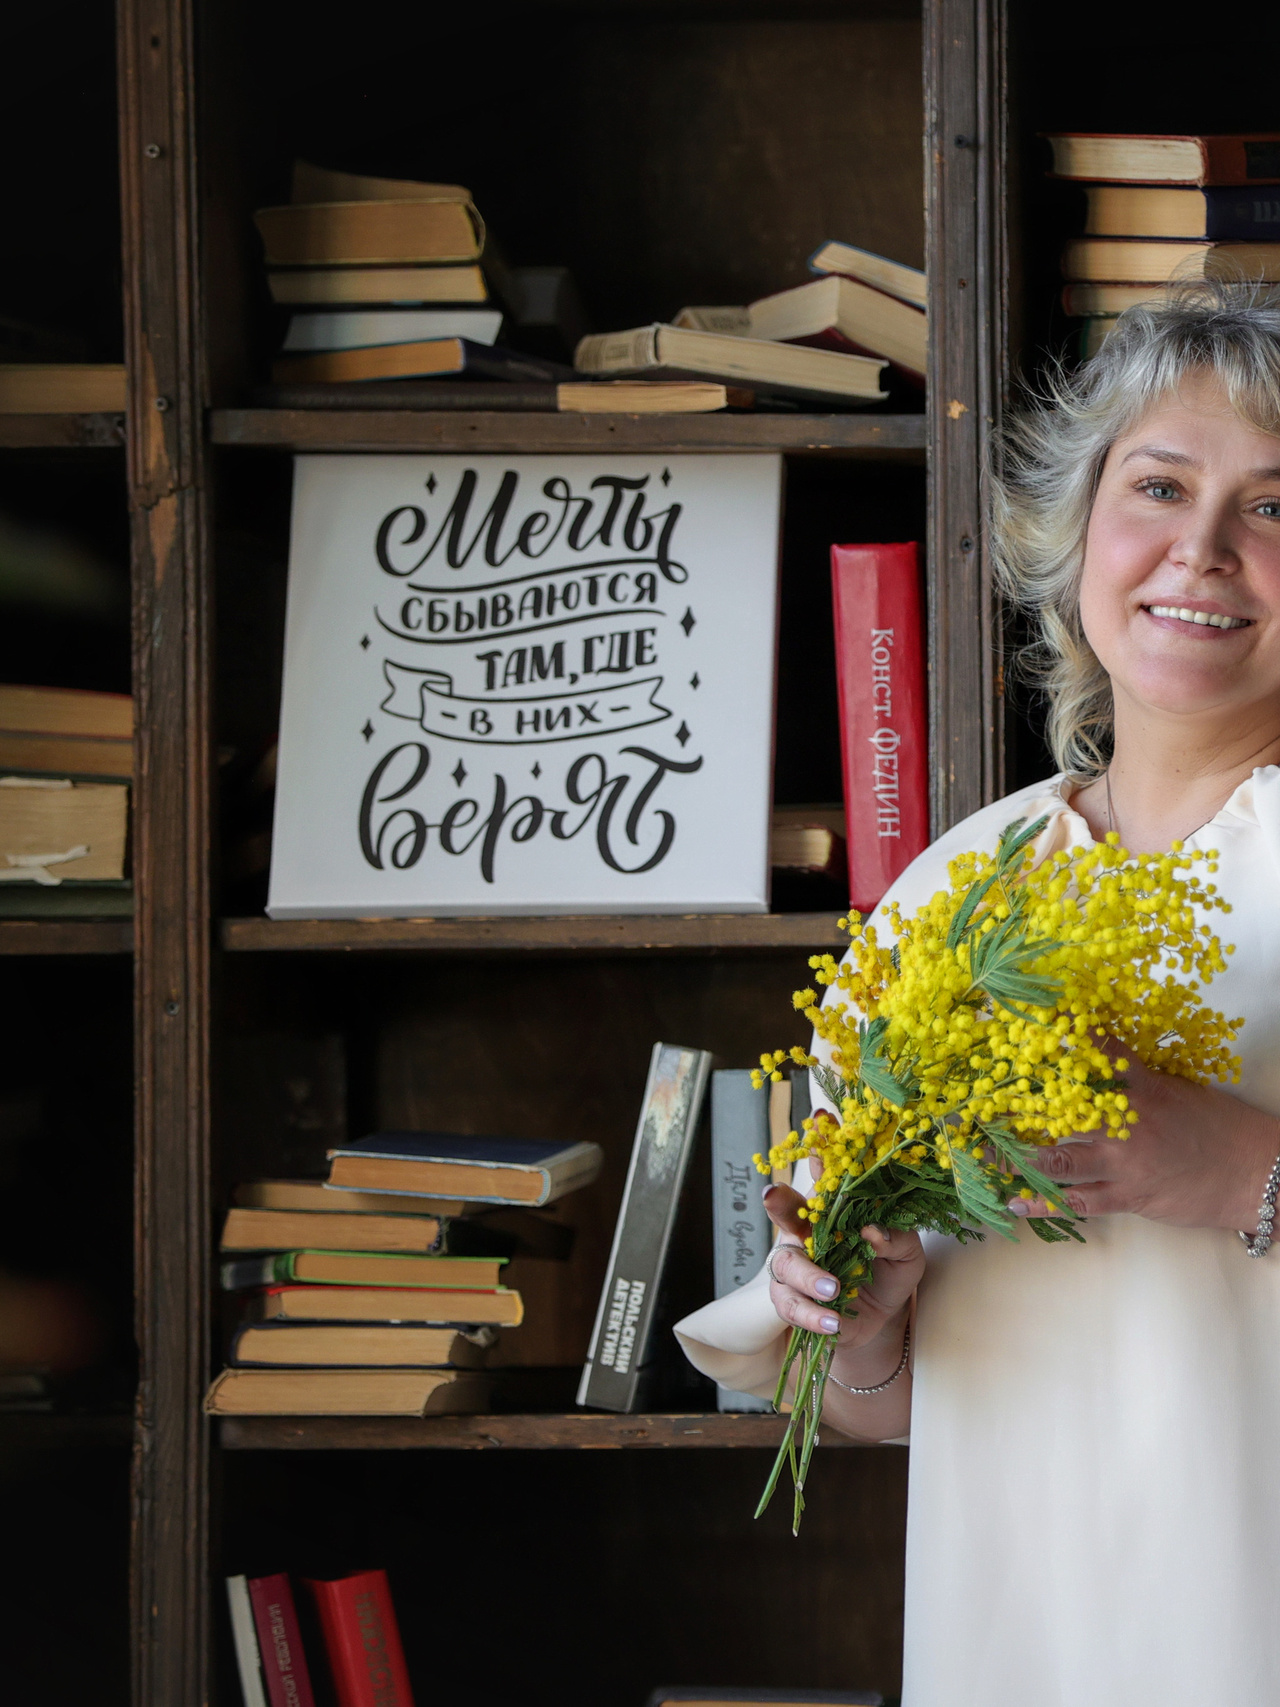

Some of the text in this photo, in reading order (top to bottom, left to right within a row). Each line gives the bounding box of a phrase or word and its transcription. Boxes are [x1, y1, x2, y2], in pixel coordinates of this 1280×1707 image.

[376, 468, 688, 583] Мечты
[400, 572, 657, 634] СБЫВАЮТСЯ
[867, 628, 899, 837] Конст. ФЕДИН
[725, 1161, 750, 1211] Дело
[730, 1219, 756, 1267] вдовы
[600, 1276, 630, 1366] ДЕТЕКТИВ
[613, 1280, 646, 1374] ПОЛЬСКИЙ
